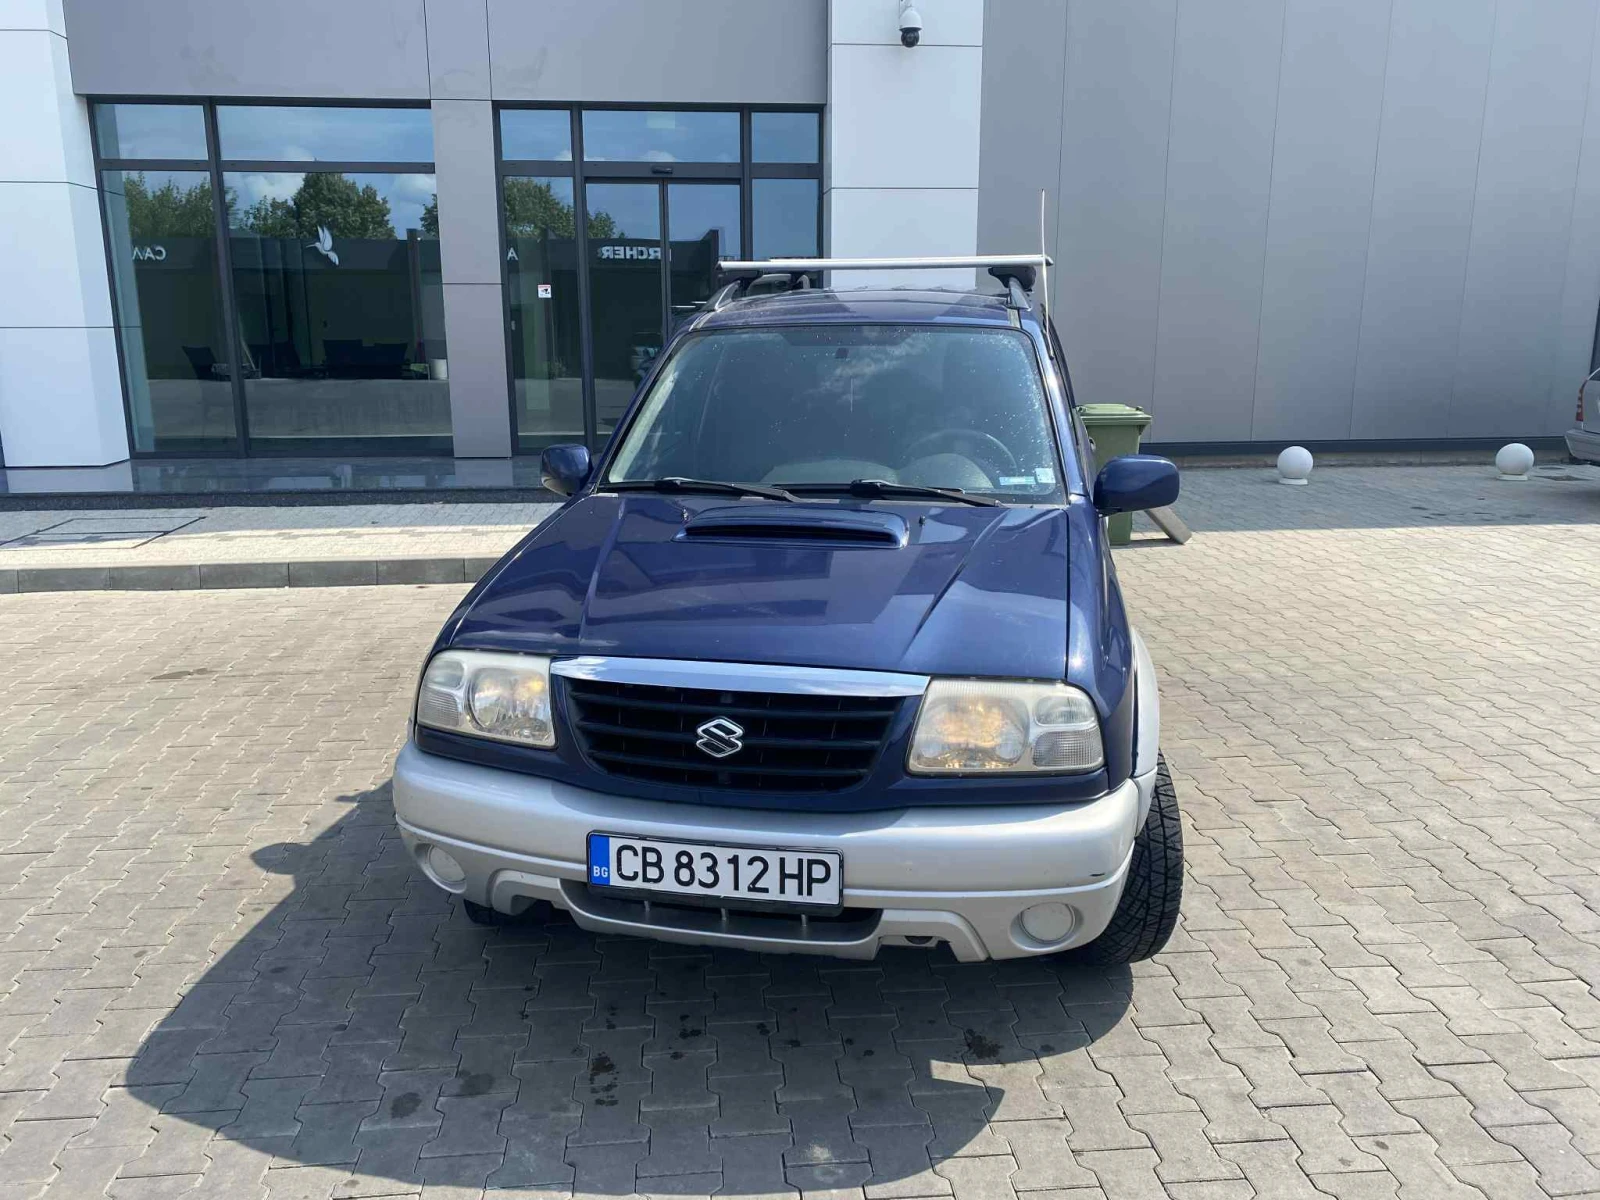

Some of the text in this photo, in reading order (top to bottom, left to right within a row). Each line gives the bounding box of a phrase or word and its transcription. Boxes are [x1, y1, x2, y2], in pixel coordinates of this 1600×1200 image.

[593, 844, 832, 896] BG CB 8312 HP
